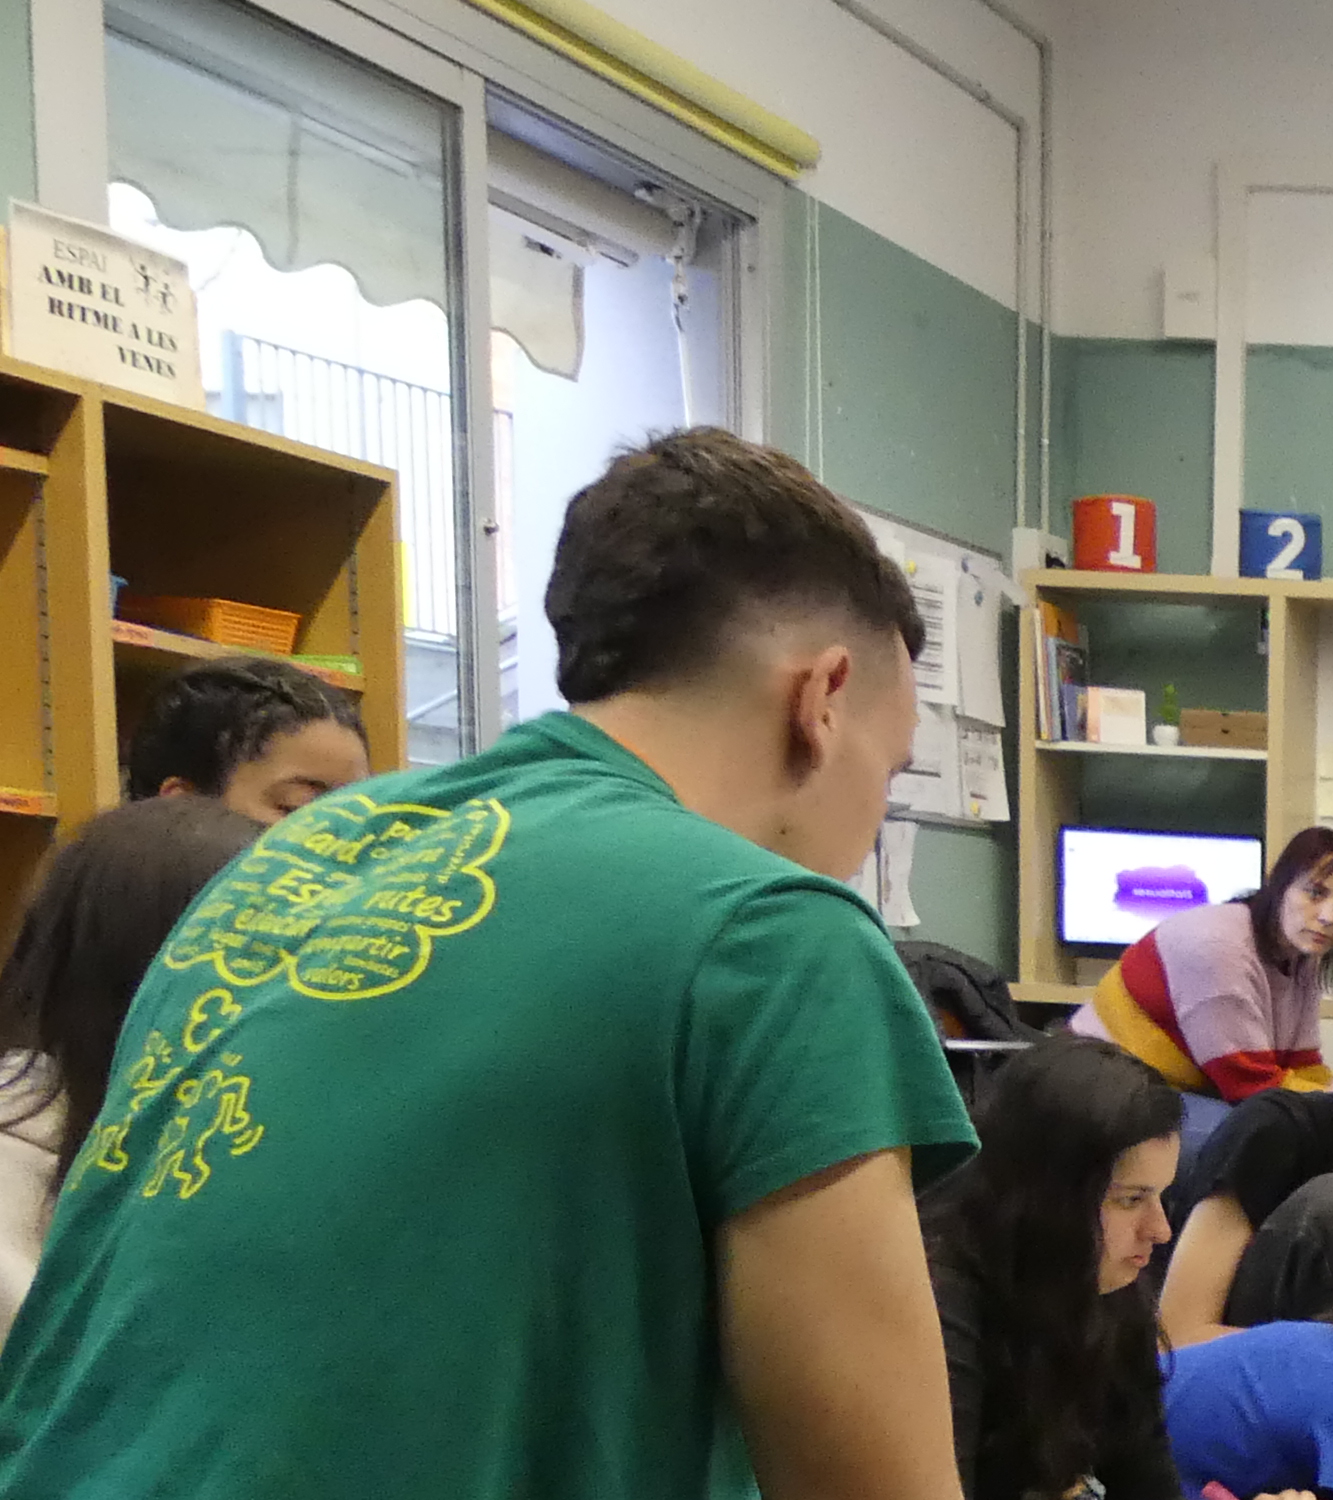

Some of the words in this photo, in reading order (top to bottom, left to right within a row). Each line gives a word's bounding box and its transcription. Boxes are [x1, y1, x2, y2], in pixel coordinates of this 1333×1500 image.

[53, 238, 108, 271] ESPAI
[42, 264, 93, 296] AMB
[100, 284, 126, 308] EL
[48, 295, 124, 335] RITME
[128, 322, 142, 341] A
[146, 326, 179, 353] LES
[117, 345, 177, 381] VENES
[1109, 502, 1143, 569] 1
[1265, 518, 1304, 580] 2
